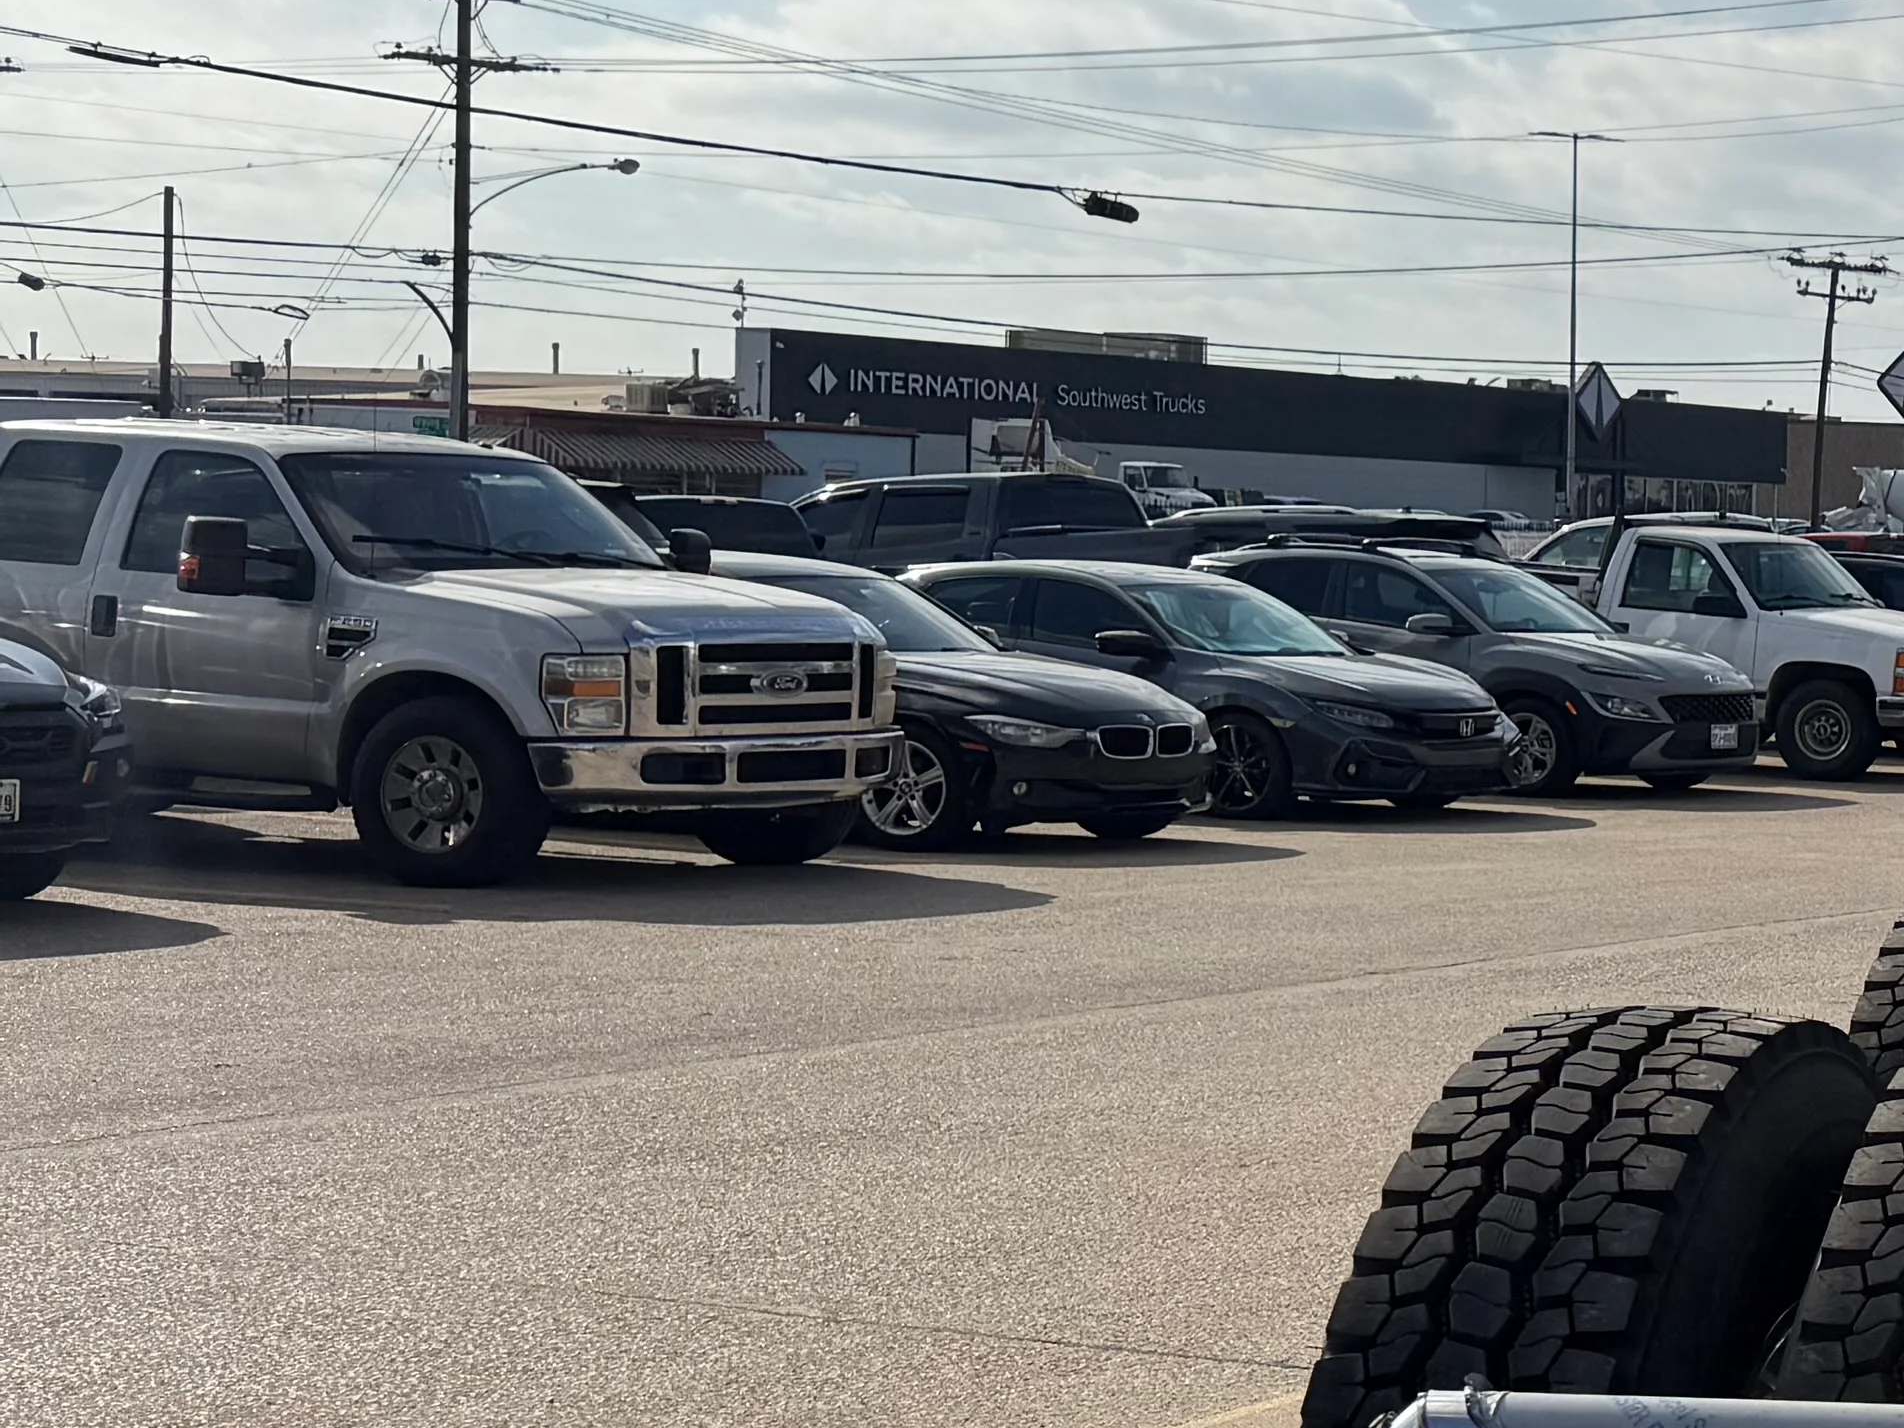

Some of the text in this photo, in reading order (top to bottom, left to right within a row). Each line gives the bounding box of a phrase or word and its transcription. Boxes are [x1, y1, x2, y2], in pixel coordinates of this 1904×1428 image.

[850, 369, 1039, 403] INTERNATIONAL
[1057, 384, 1206, 414] Southwest Trucks
